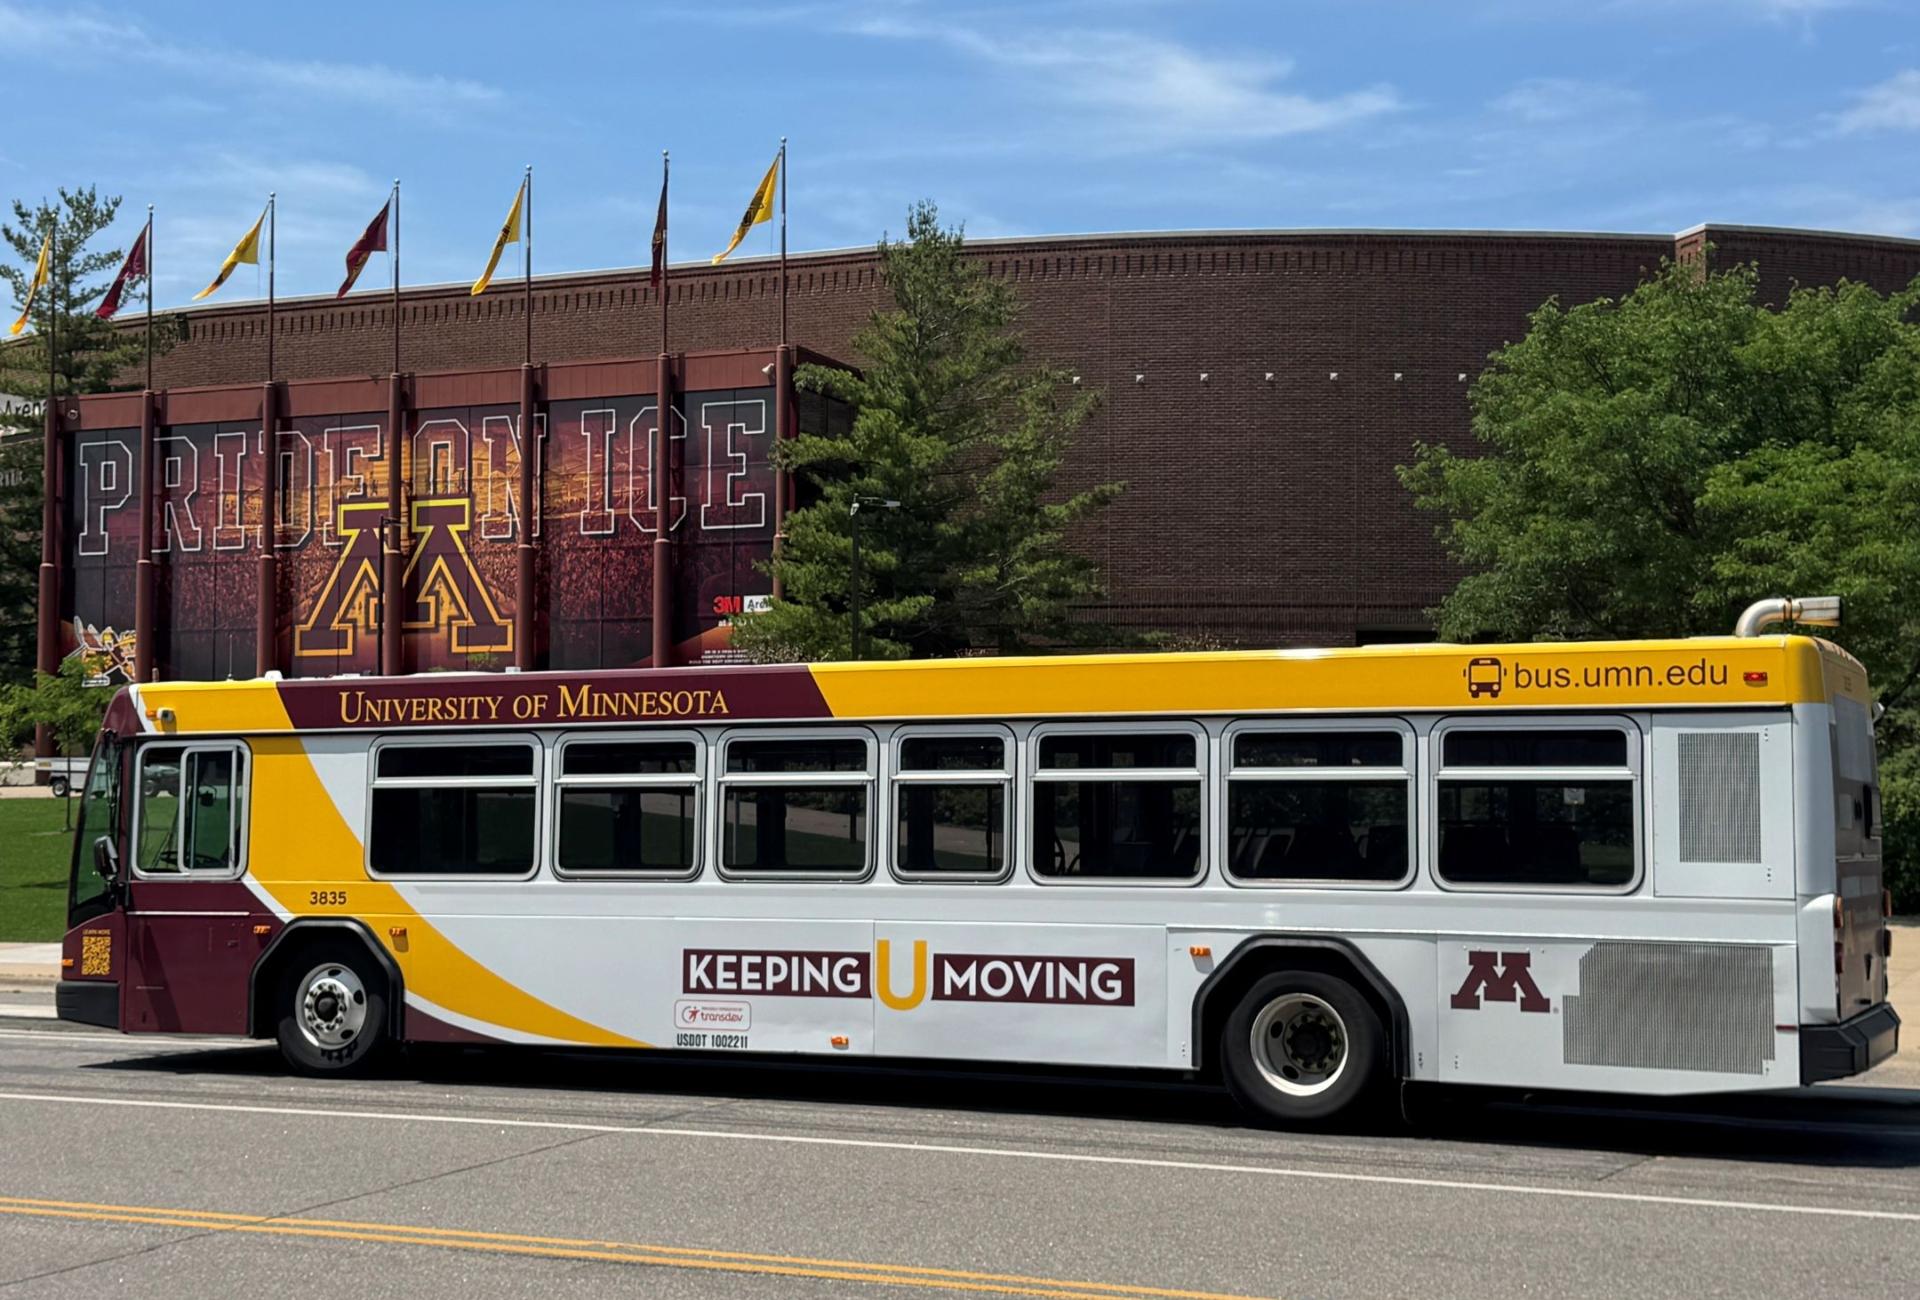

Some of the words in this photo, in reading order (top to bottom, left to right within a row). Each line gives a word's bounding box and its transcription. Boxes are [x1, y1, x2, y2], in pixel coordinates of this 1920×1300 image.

[413, 412, 547, 539] ON
[580, 399, 766, 535] ICE
[713, 596, 741, 613] 3M
[1513, 658, 1729, 690] bus.umn.edu
[339, 691, 503, 724] UNIVERSITY
[513, 694, 549, 719] OF
[556, 684, 730, 718] MINNESOTA
[309, 891, 347, 905] 3835
[689, 954, 862, 993] KEEPING
[876, 939, 928, 1011] U
[943, 960, 1123, 1001] MOVING
[1450, 950, 1551, 1013] M
[701, 1012, 743, 1021] transdev
[677, 1033, 707, 1047] USDOT
[712, 1034, 748, 1048] 1002211
